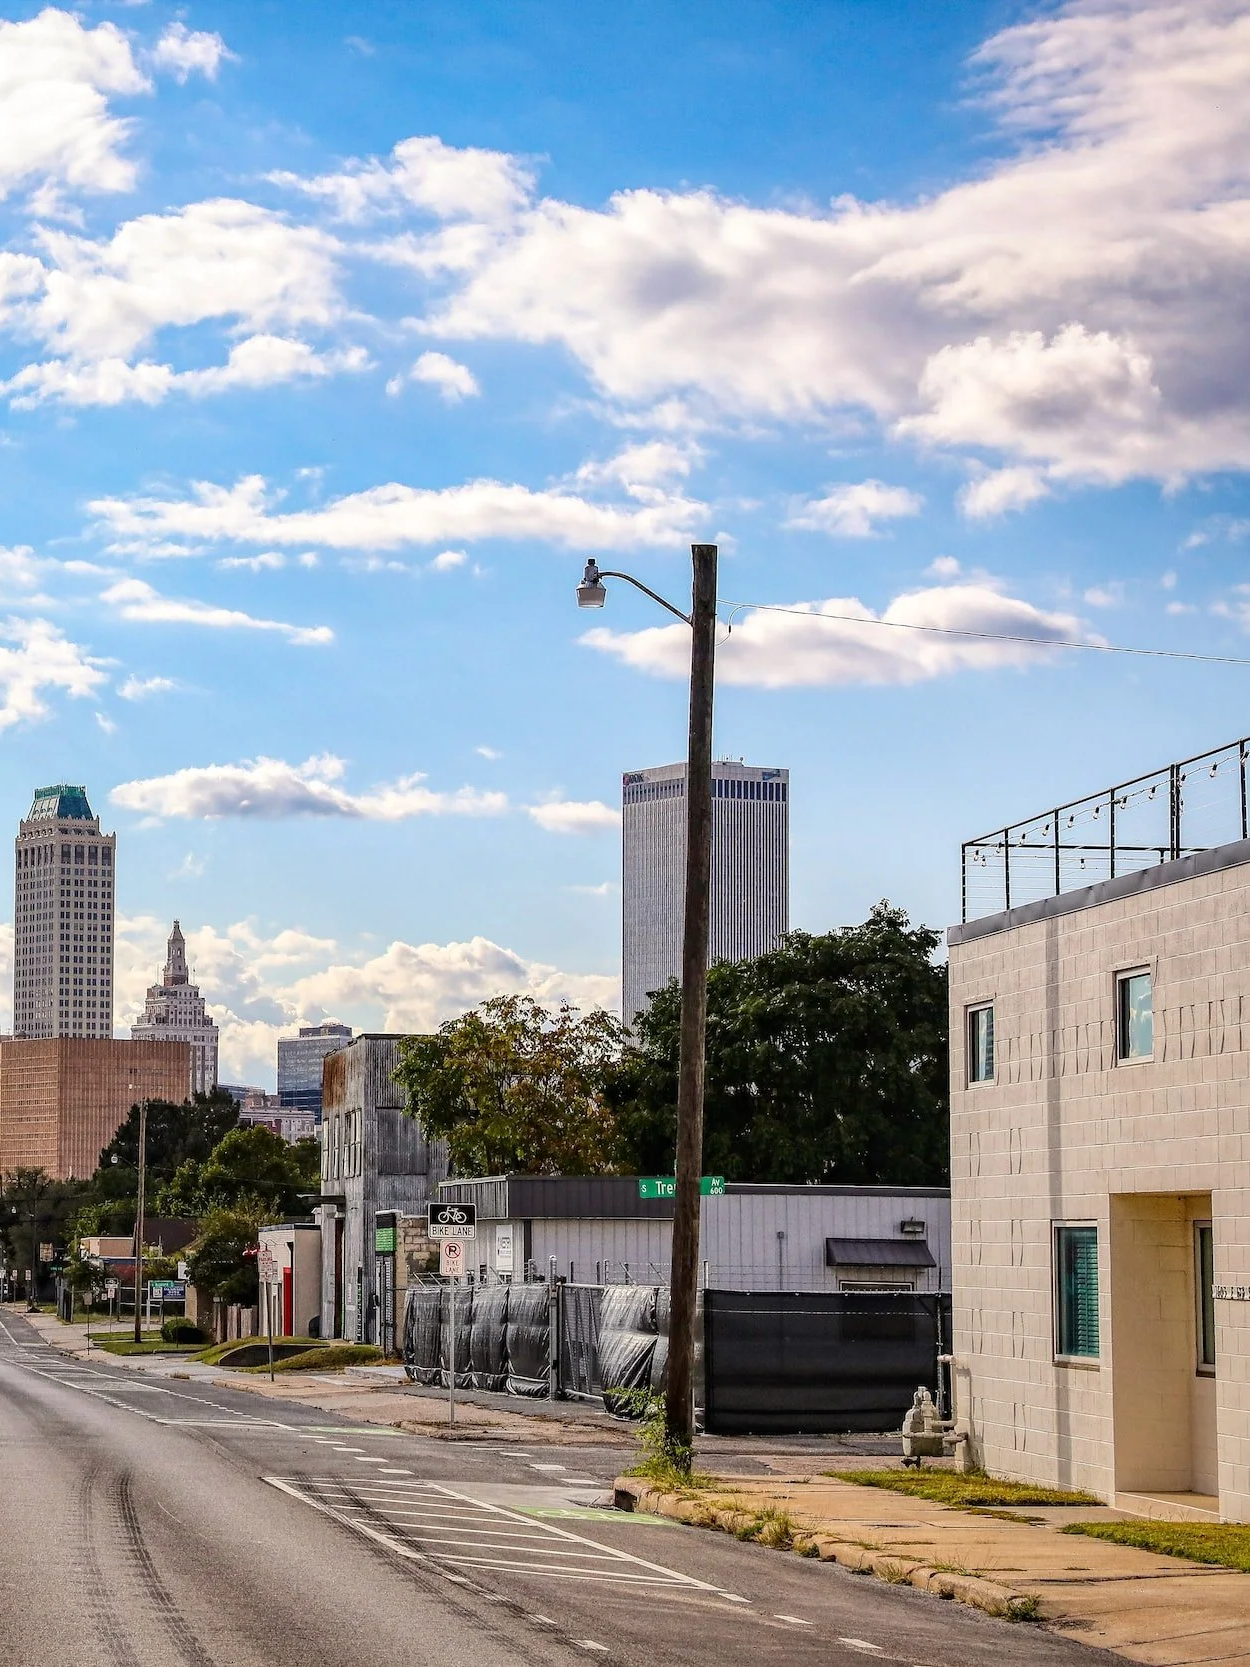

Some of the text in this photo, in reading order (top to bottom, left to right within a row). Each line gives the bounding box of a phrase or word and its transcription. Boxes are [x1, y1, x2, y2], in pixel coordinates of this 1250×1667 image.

[711, 1178, 720, 1187] Av
[710, 1187, 723, 1195] 600
[432, 1226, 473, 1236] BIKE LANE
